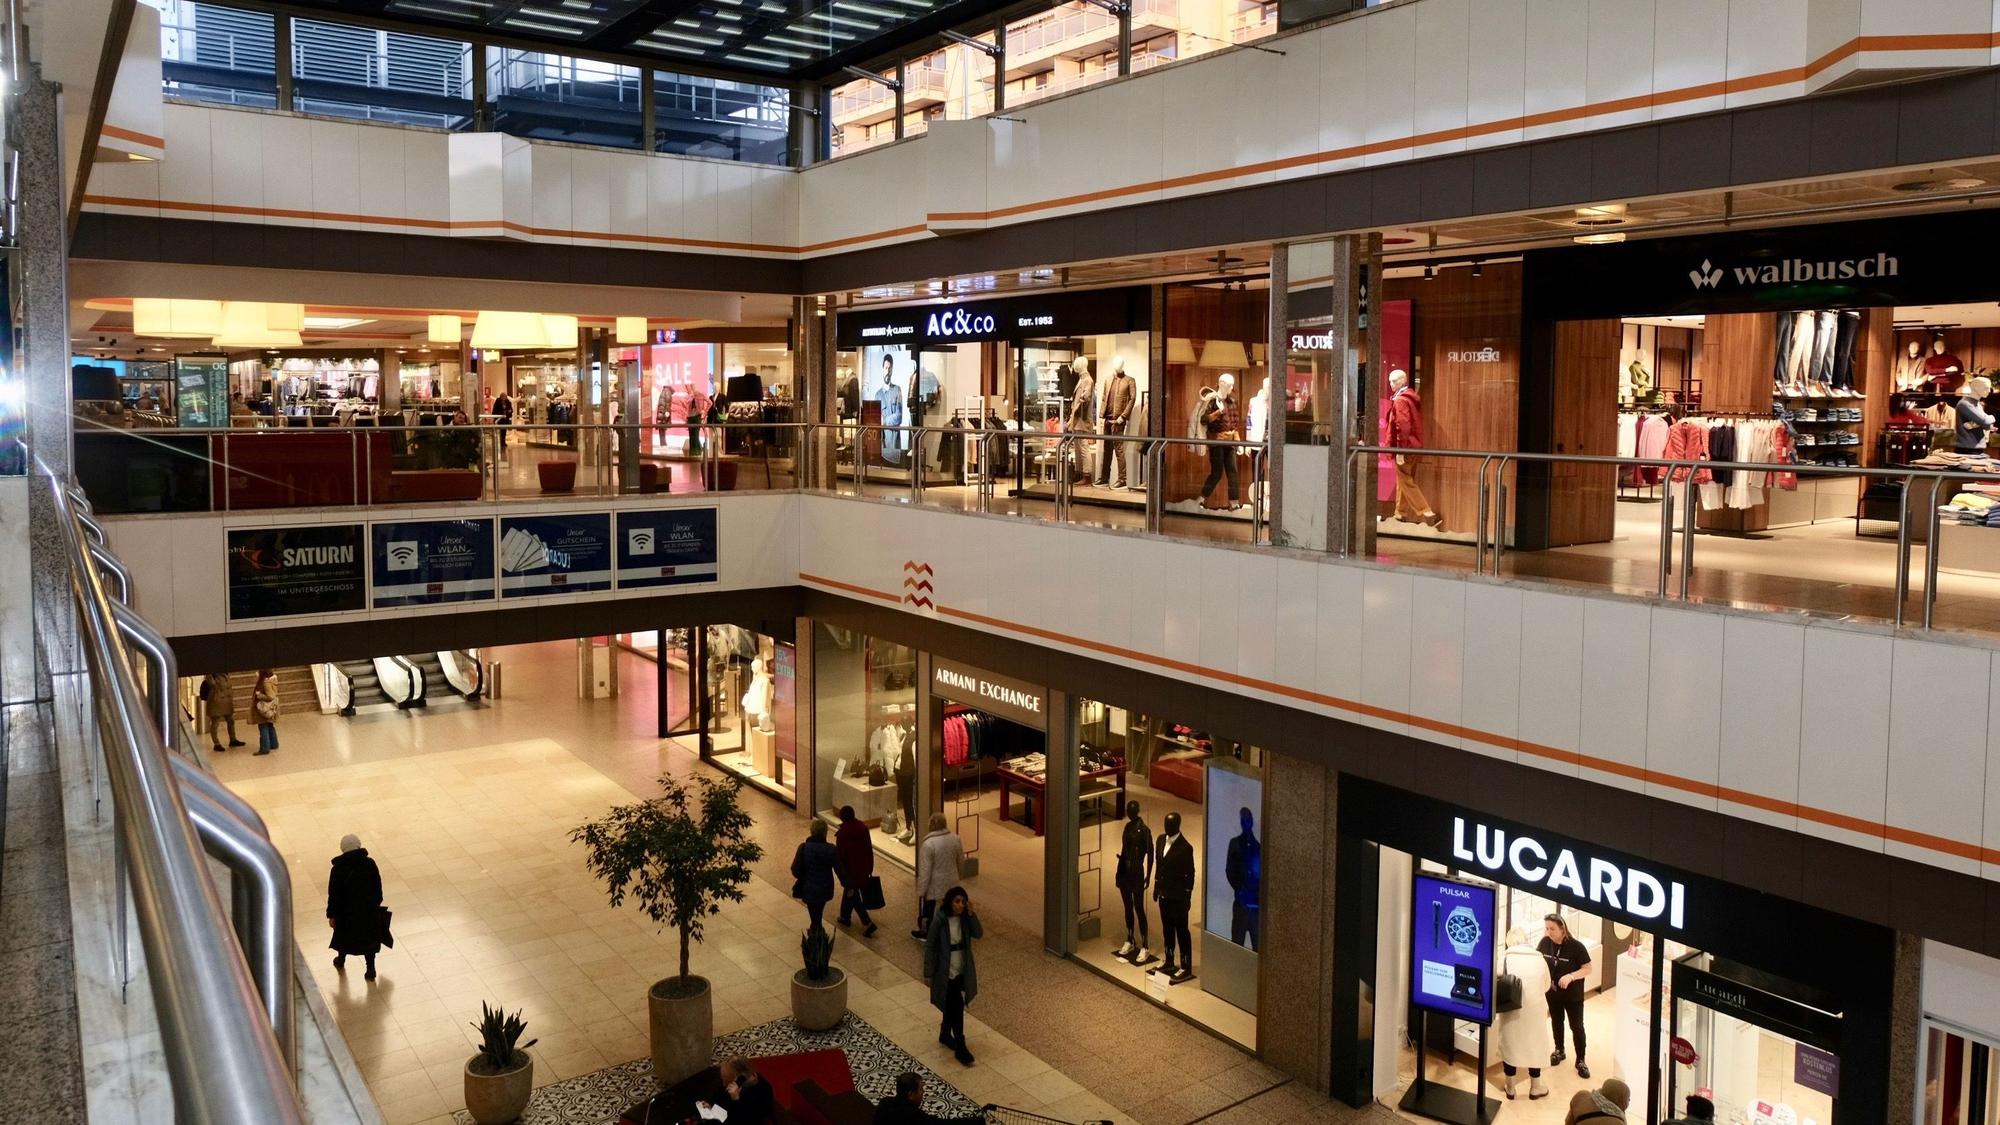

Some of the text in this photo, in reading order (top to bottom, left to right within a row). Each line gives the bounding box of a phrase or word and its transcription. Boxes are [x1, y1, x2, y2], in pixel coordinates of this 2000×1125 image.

[1733, 253, 1898, 285] walbusch
[893, 326, 914, 334] CLASSICS
[212, 362, 226, 370] OG
[655, 362, 692, 385] SALE
[556, 536, 597, 545] GUTSCHEIN
[670, 532, 694, 540] WLAN
[437, 544, 466, 553] WLAN
[283, 545, 354, 567] SATURN
[290, 583, 355, 594] UNTERGESCHOSS
[936, 667, 1041, 712] ARMANI EXCHANGE
[1453, 816, 1685, 930] LUCARDI
[1439, 886, 1470, 899] PULSAR
[1695, 979, 1747, 1007] Lucardi
